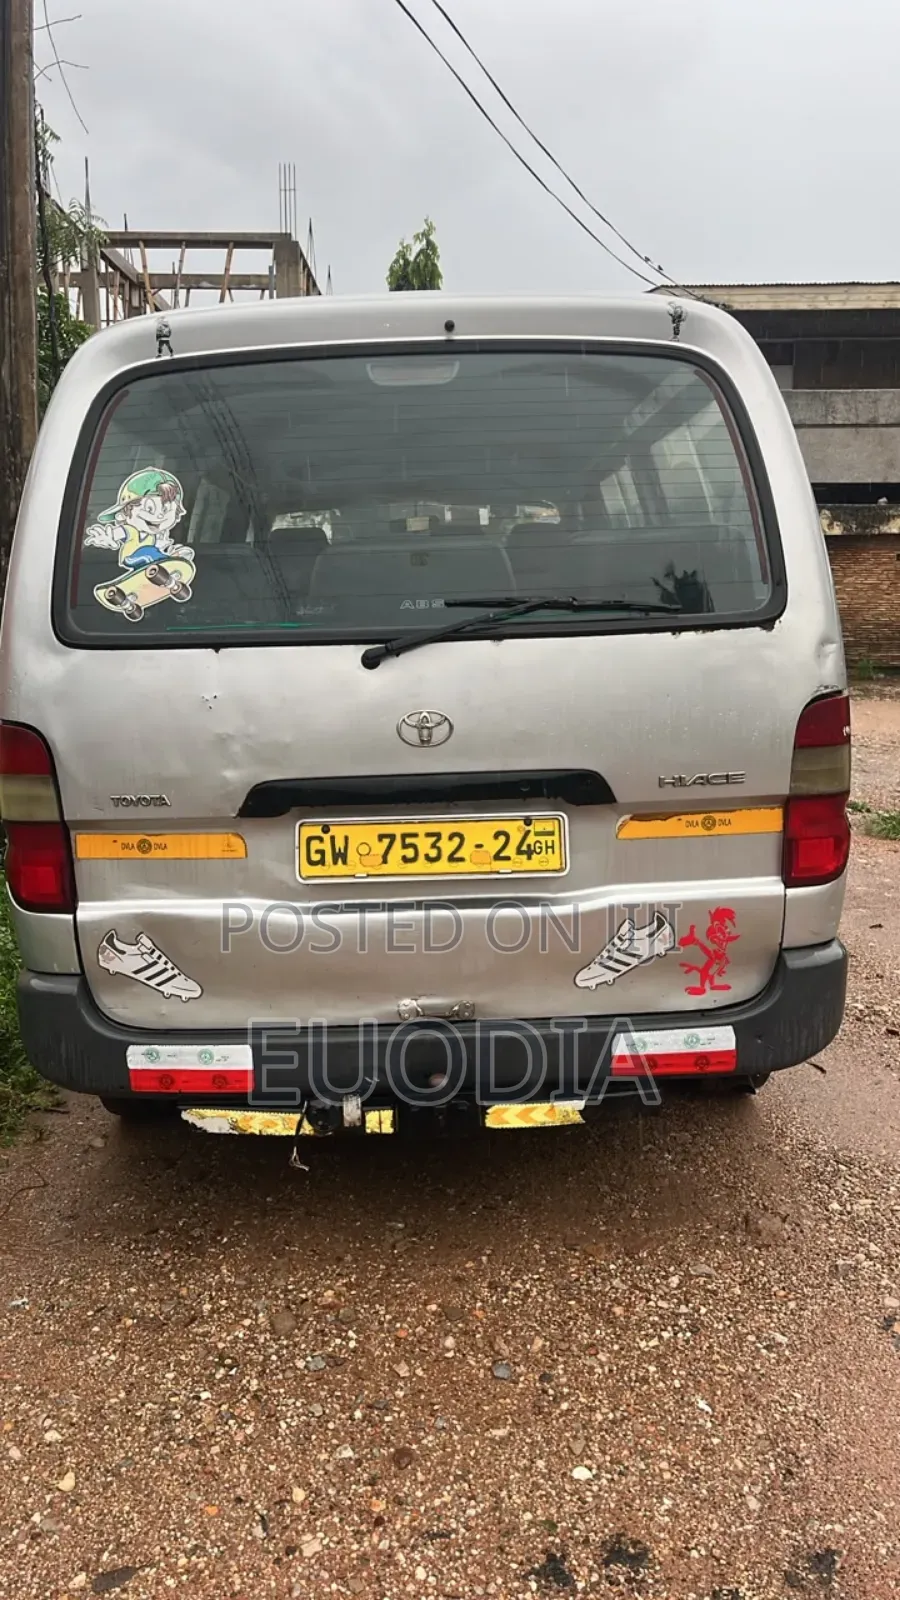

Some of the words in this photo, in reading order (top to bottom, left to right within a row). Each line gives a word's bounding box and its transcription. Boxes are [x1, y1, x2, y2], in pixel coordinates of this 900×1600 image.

[658, 771, 746, 788] HIACE
[110, 794, 171, 808] TOYOTA
[685, 820, 699, 828] DVLA
[717, 818, 732, 827] DVLA
[120, 843, 135, 851] DVLA
[153, 842, 168, 851] DVLA
[305, 834, 349, 867] GW
[533, 839, 555, 856] GH
